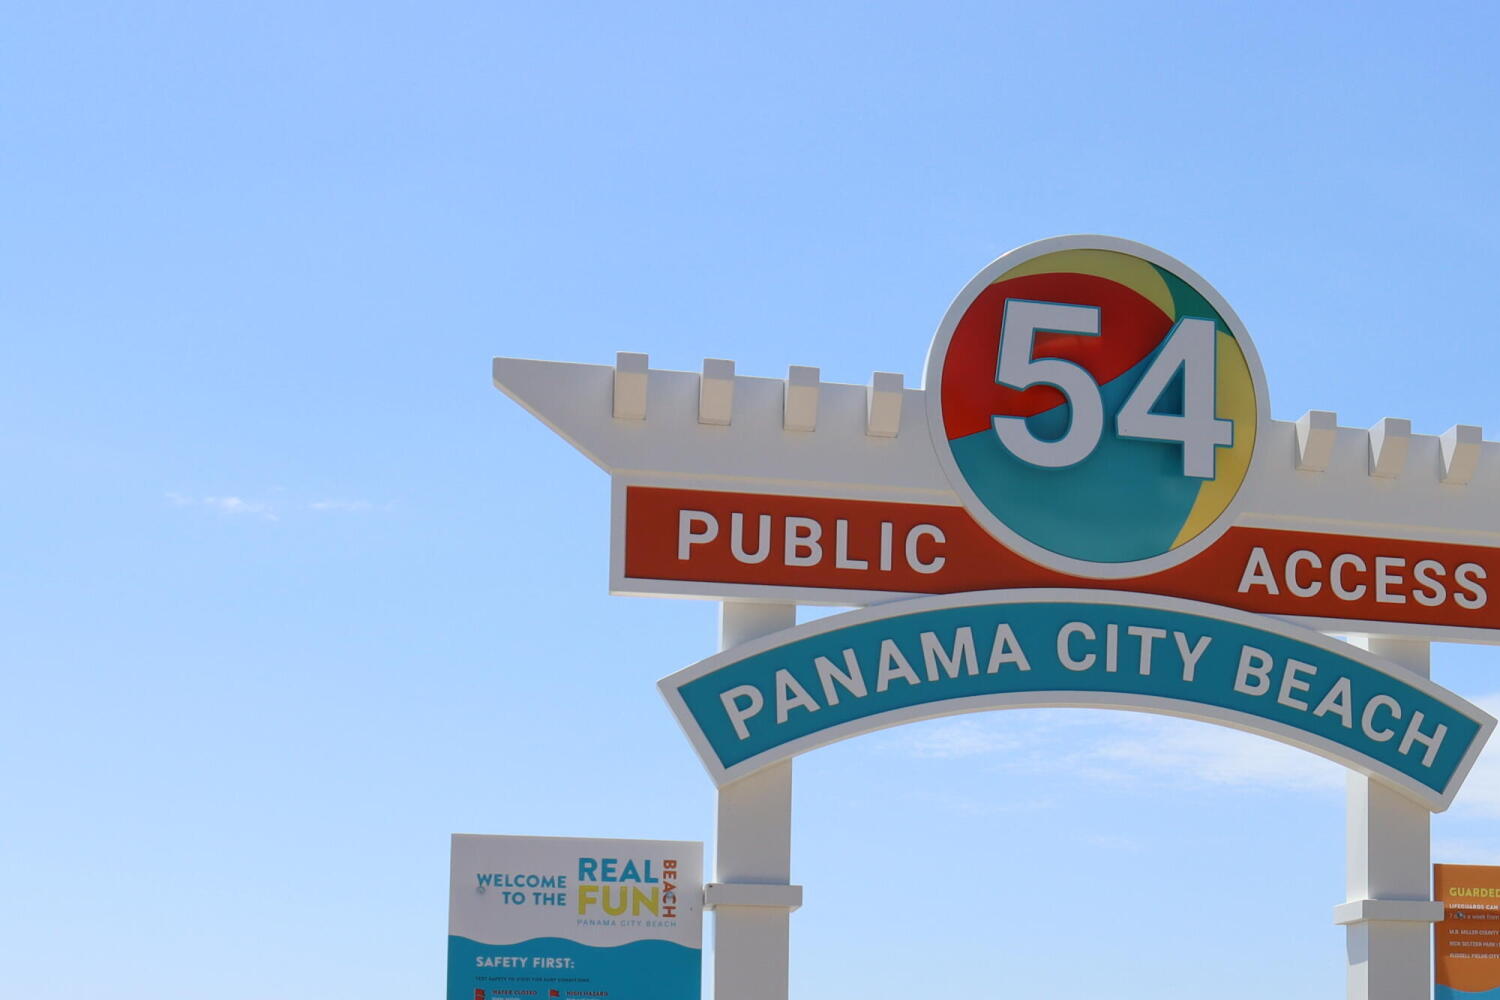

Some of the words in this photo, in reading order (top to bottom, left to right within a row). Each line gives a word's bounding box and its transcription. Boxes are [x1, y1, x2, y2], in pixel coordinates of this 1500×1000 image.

[990, 298, 1234, 481] 54
[677, 509, 947, 575] PUBLIC
[1237, 546, 1488, 610] ACCESS
[719, 622, 1032, 741] PANAMA
[1056, 621, 1213, 682] CITY
[1233, 644, 1449, 769] BEACH
[477, 873, 567, 889] WELCOME
[578, 857, 659, 883] REAL
[502, 891, 525, 905] TO
[532, 892, 566, 906] THE
[578, 885, 659, 917] FUN
[662, 859, 677, 918] BEACH
[646, 920, 677, 928] BEACH
[476, 956, 528, 968] SAFETY
[533, 957, 575, 969] FIRST:
